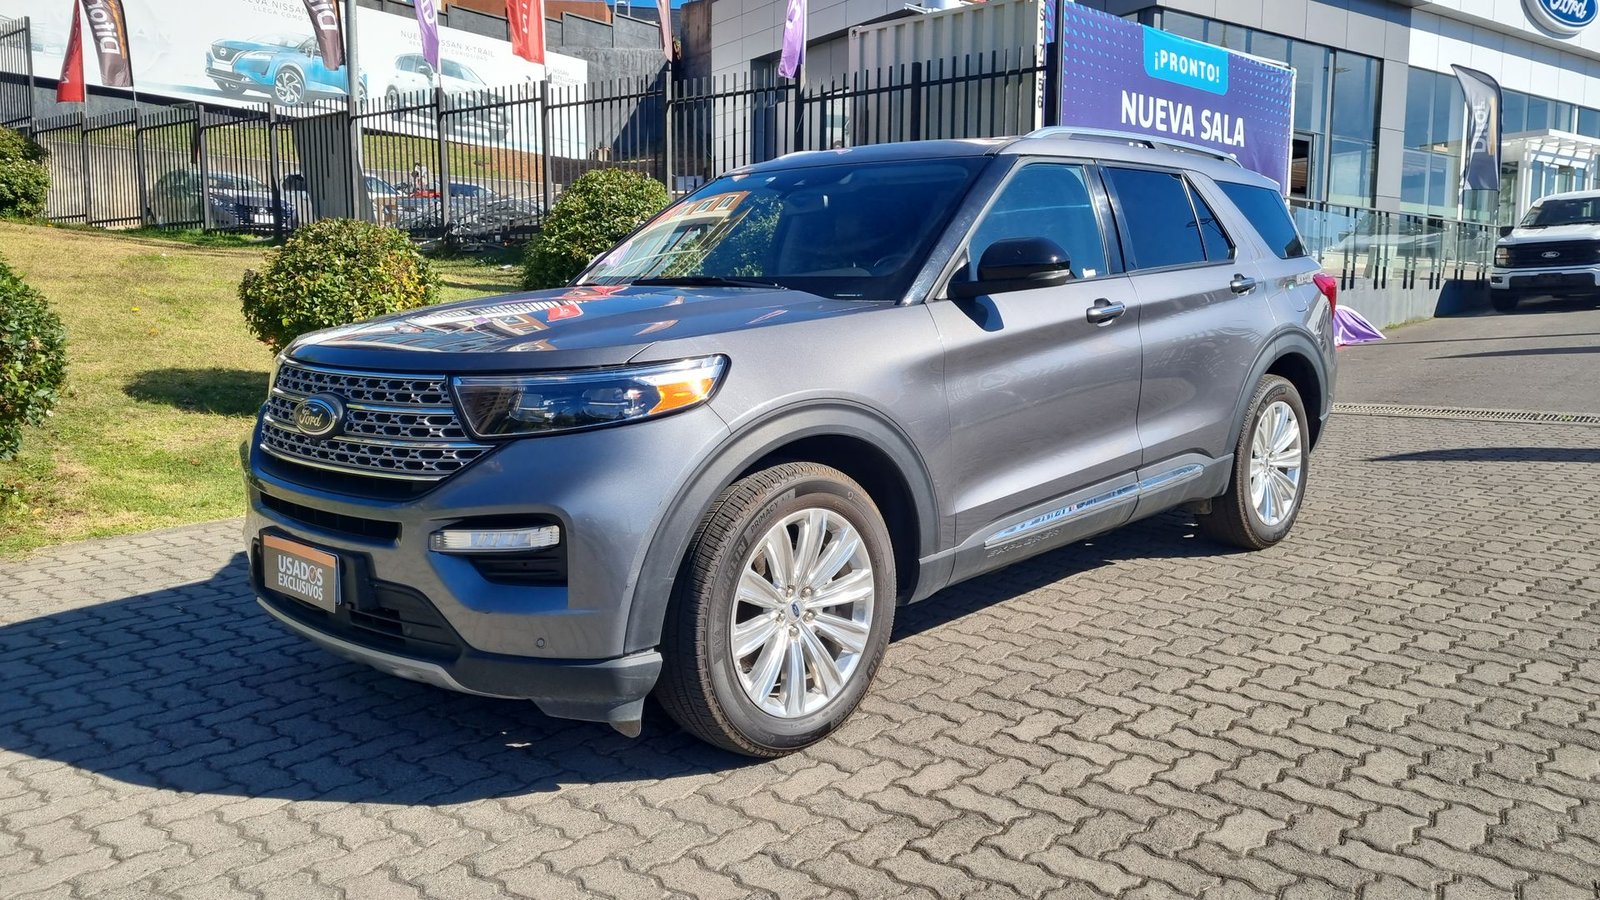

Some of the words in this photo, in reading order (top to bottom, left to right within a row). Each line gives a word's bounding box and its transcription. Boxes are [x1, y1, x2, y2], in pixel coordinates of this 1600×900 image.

[400, 30, 421, 41] NUE
[441, 39, 462, 49] SSAN
[1154, 49, 1220, 83] ¡PRONTO!
[1121, 90, 1195, 138] NUEVA
[1200, 109, 1245, 148] SALA
[299, 408, 323, 427] Ford
[750, 500, 779, 533] PRIMACY
[278, 554, 323, 586] USADOS
[278, 573, 323, 601] EXCLUSIVOS
